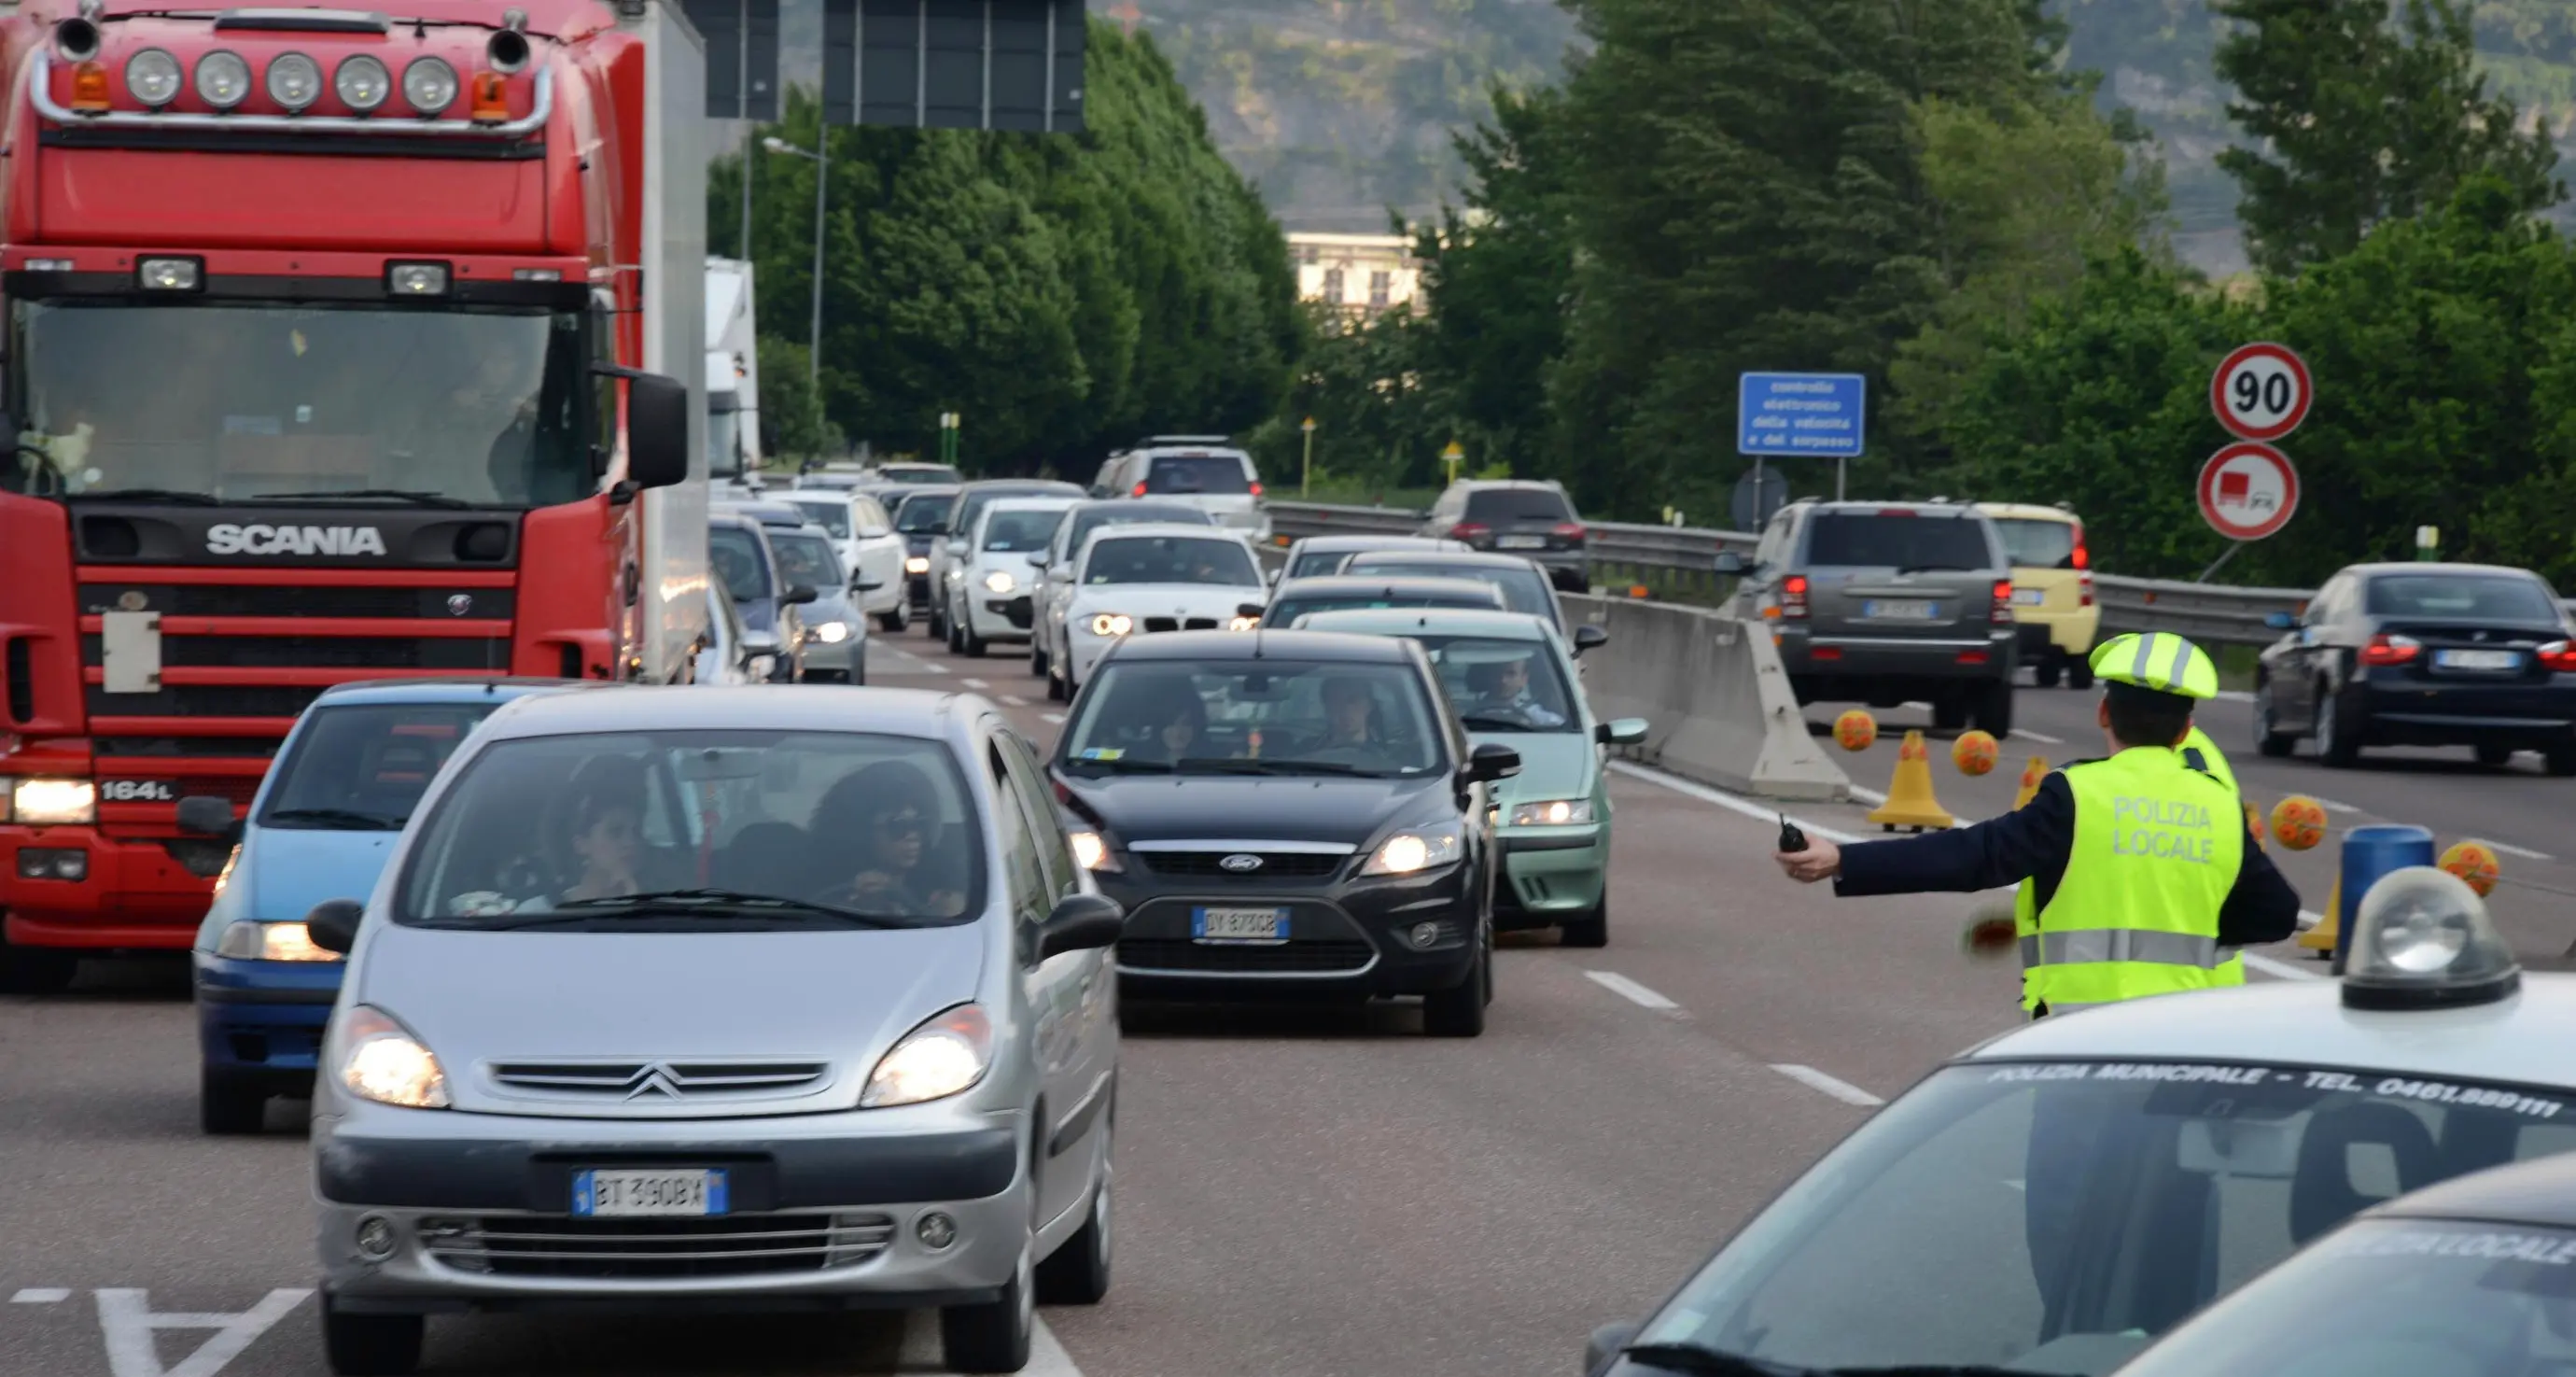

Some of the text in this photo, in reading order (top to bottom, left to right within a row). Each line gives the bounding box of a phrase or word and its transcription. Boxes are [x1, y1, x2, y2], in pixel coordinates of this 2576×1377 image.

[2234, 370, 2291, 415] 90
[205, 524, 387, 555] SCANIA
[2113, 795, 2213, 831] POLIZIA
[2113, 829, 2214, 864] LOCALE
[2093, 1062, 2272, 1086] MUNICIPALE
